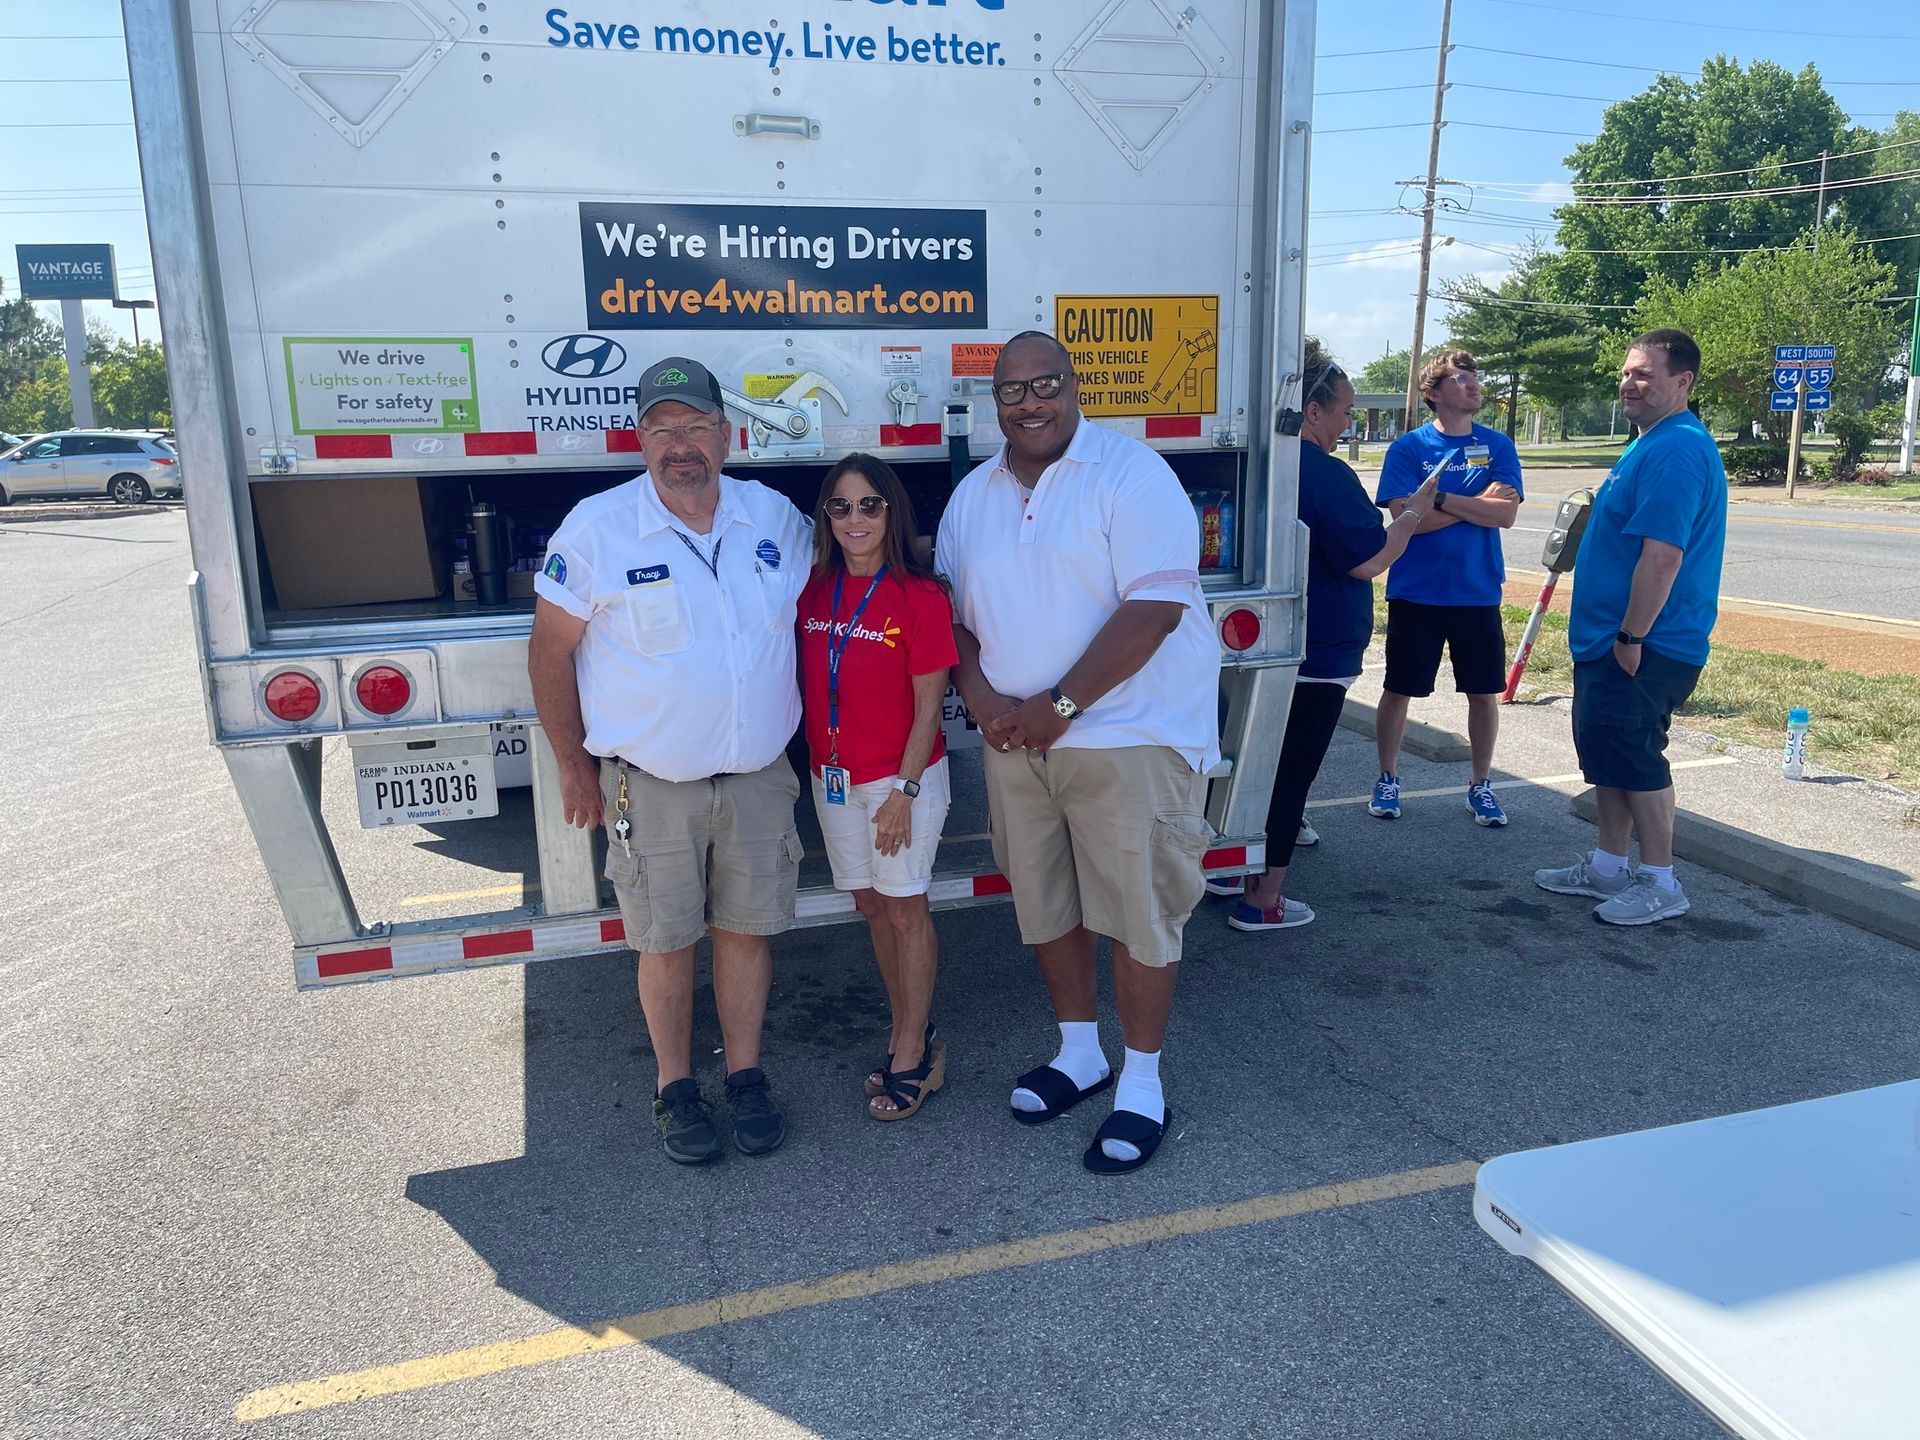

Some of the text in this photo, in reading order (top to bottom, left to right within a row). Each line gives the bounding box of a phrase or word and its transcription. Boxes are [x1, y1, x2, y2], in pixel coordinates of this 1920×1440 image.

[546, 9, 1006, 68] Save money. Live better.
[596, 222, 973, 269] We're Hiring Drivers
[27, 262, 103, 275] VANTAGE
[600, 278, 974, 315] drive4walmart.com
[1064, 307, 1154, 343] CAUTION
[338, 349, 426, 365] We drive
[1098, 350, 1149, 364] VEHICLE
[1780, 348, 1803, 358] WEST
[1808, 348, 1833, 358] SOUTH
[310, 373, 383, 390] Lights on
[396, 373, 468, 388] Text-free
[1079, 371, 1145, 385] AKES WIDE
[1778, 370, 1799, 385] 64
[1809, 369, 1830, 385] 55
[337, 393, 434, 414] For safety
[525, 386, 638, 406] HYUNDA
[1109, 390, 1149, 404] TURNS
[527, 414, 637, 432] TRANSLEA
[634, 570, 661, 582] Tracy
[393, 762, 456, 776] INDIANA
[375, 774, 478, 810] PD13036
[407, 808, 441, 819] Walmart
